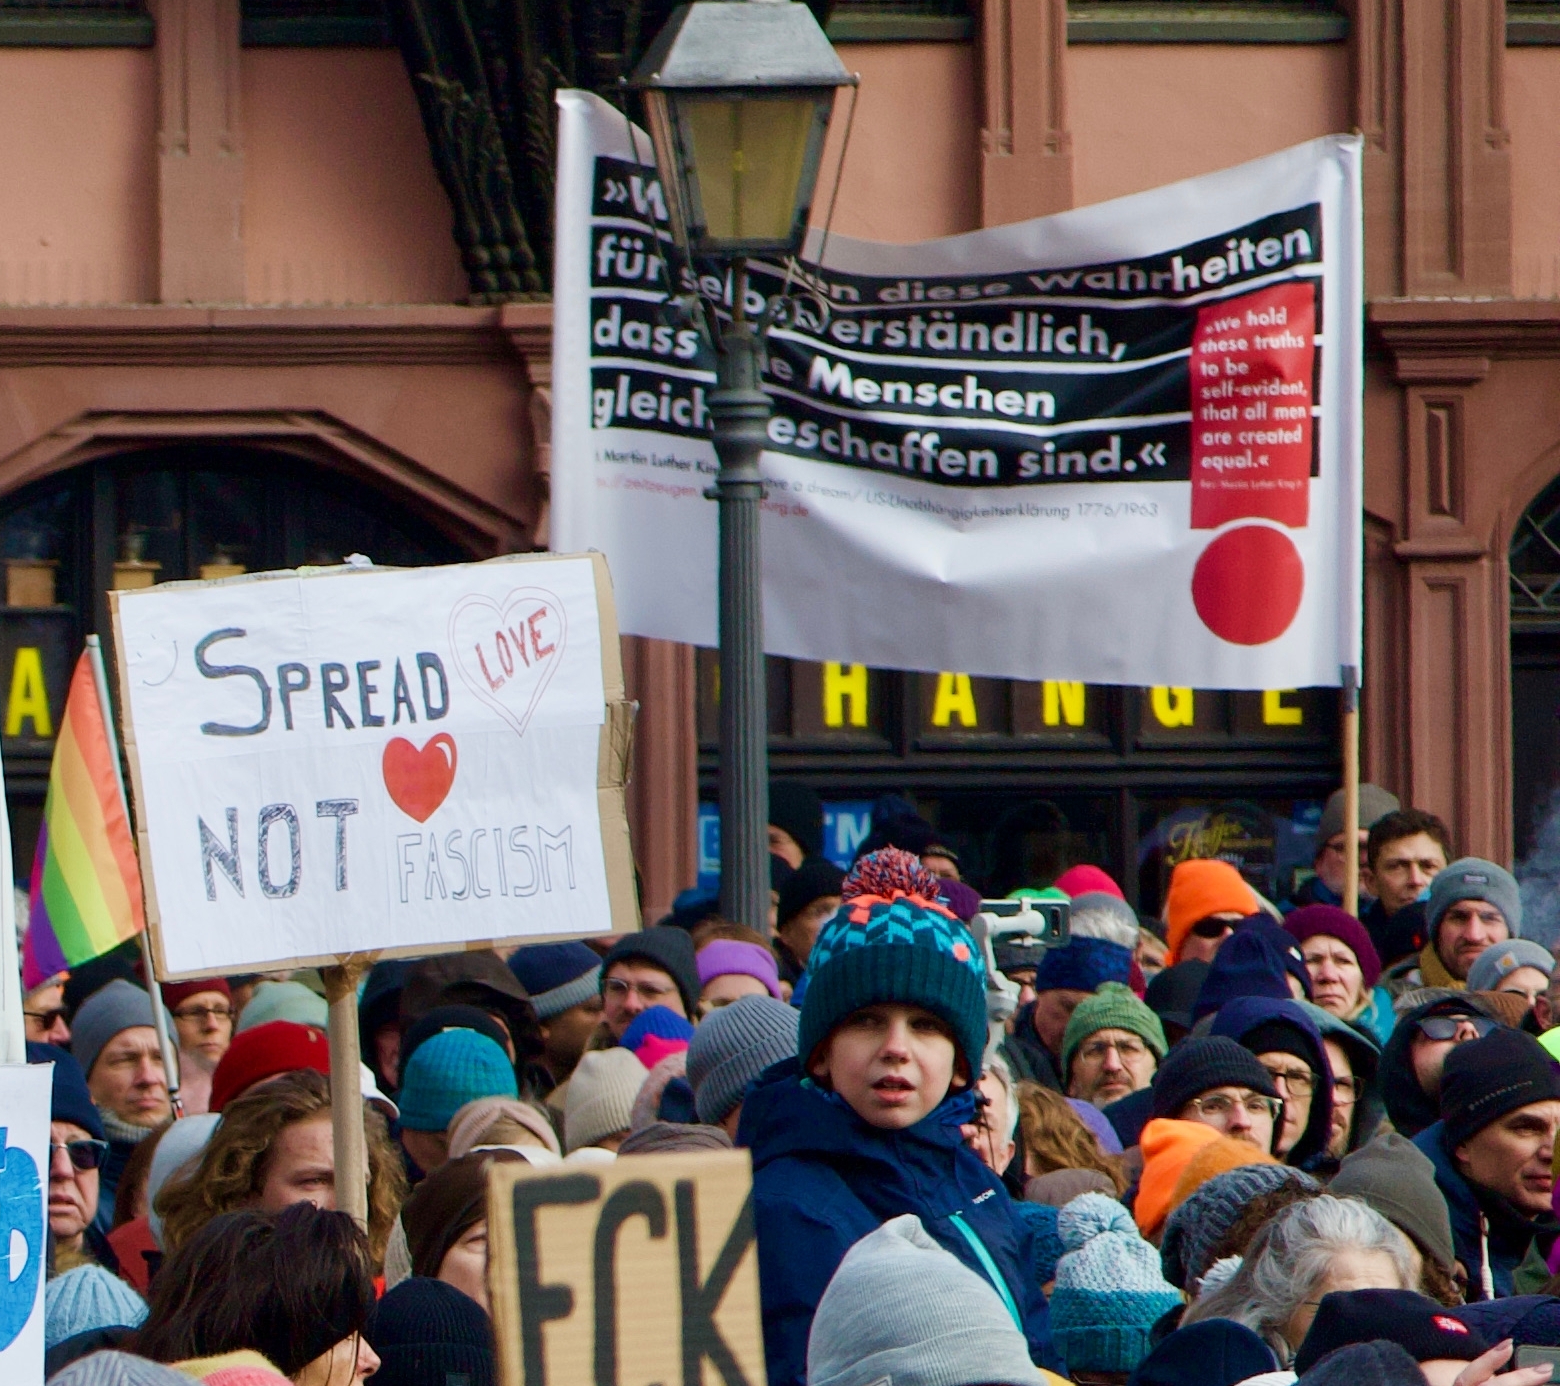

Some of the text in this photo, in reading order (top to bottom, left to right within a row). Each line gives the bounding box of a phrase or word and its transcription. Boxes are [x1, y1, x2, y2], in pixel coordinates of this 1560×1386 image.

[596, 233, 665, 282] für
[876, 278, 1014, 303] diese
[1246, 306, 1288, 327] hold
[1254, 329, 1306, 351] truths
[593, 314, 699, 359] dass
[806, 355, 1056, 420] Menschen
[1200, 356, 1250, 377] to be
[1200, 378, 1308, 400] self-evident,
[1201, 400, 1307, 422] that all men
[765, 414, 999, 479] eschaffen
[1018, 435, 1168, 477] sind.«
[1200, 424, 1303, 446] are created
[194, 606, 556, 737] SPREAD LOVE
[197, 798, 577, 904] NOT FASCISM
